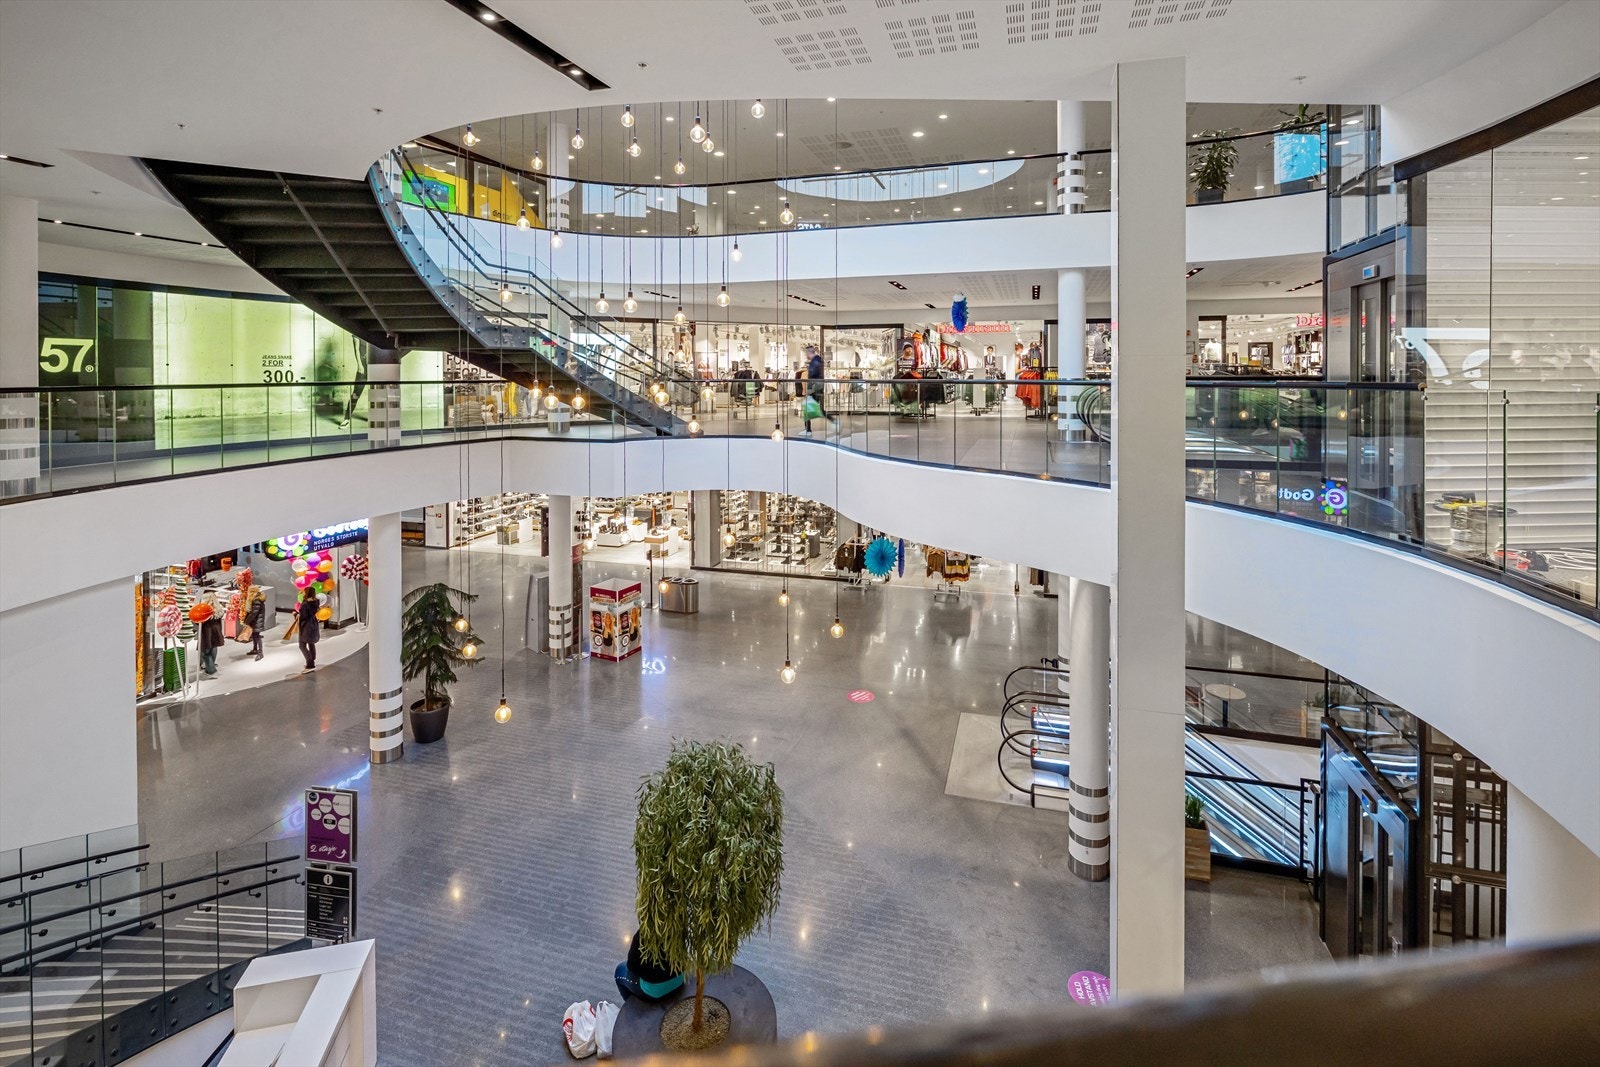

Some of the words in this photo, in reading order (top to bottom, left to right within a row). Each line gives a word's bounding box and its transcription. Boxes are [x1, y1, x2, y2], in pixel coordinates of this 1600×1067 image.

[446, 367, 493, 379] EOPLE
[313, 536, 335, 546] NORGES
[1074, 981, 1085, 999] HOLD
